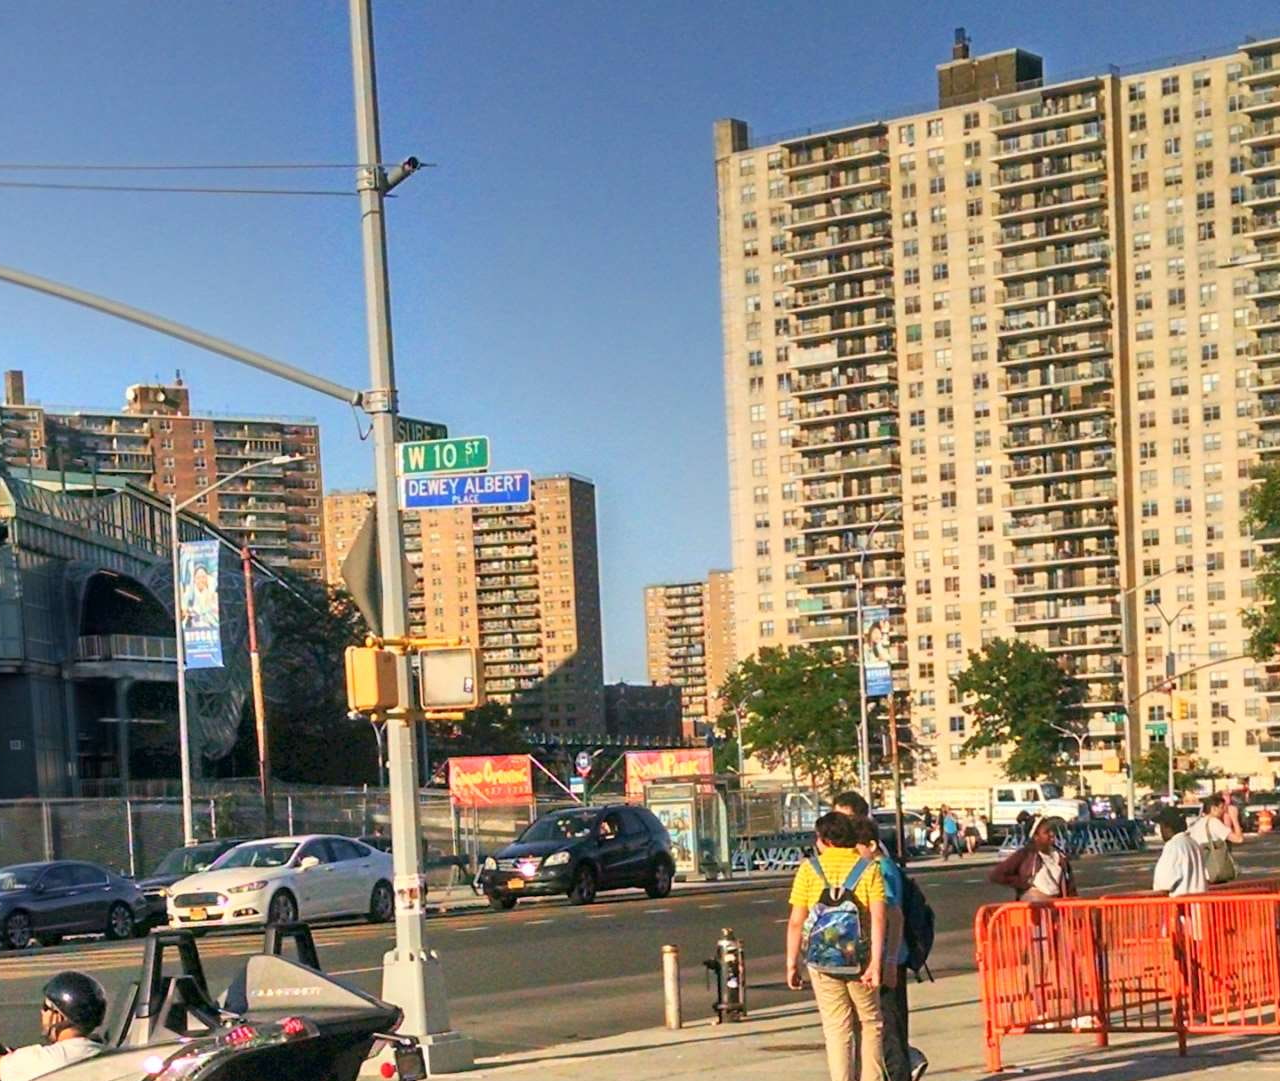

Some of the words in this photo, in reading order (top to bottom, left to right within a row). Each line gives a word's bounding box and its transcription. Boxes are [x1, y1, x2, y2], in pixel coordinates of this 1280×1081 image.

[408, 446, 425, 471] W
[433, 443, 457, 468] 10
[465, 441, 480, 455] ST
[408, 478, 459, 496] DEWEY
[464, 474, 523, 494] ALBERT
[452, 494, 480, 504] PLACE
